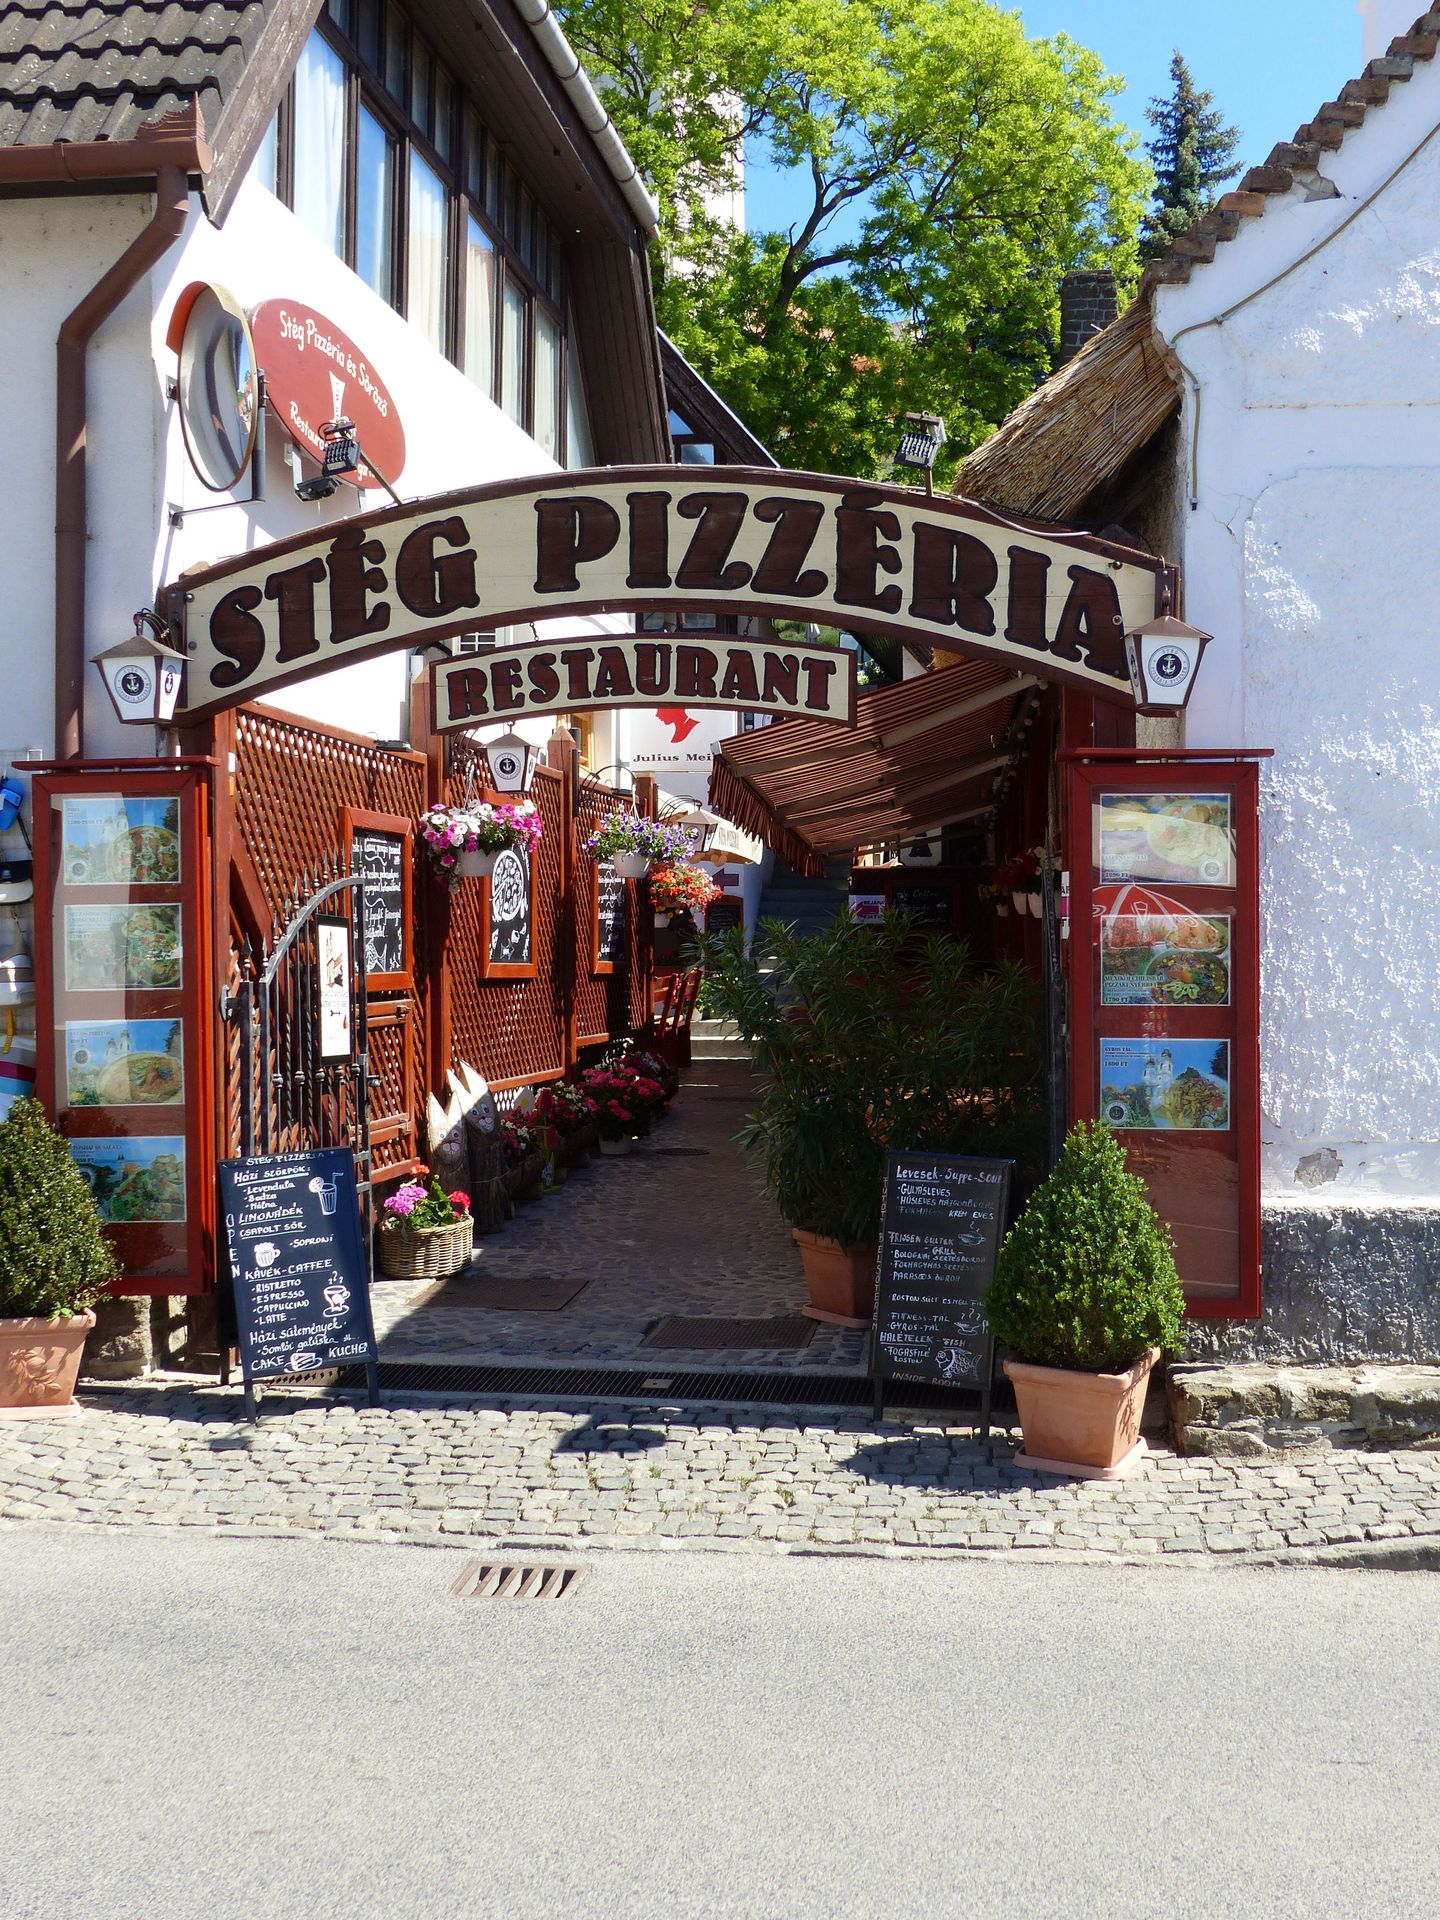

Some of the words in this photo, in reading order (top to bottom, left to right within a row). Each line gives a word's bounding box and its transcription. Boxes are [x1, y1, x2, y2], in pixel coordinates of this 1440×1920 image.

[280, 310, 304, 351] Stég
[305, 319, 345, 368] Pizzéria
[347, 354, 357, 378] és
[209, 515, 480, 688] STÉG
[533, 490, 1130, 682] PIZZÉRIA
[446, 643, 837, 721] RESTAURANT
[633, 753, 680, 762] Julius
[240, 1225, 281, 1238] CSAPOLT
[255, 1279, 302, 1293] RISTRETTO
[256, 1290, 305, 1304] ESPRESSO
[256, 1299, 310, 1314] CAPPUCCINO
[259, 1313, 287, 1325] LATTE
[251, 1355, 286, 1371] CAKE
